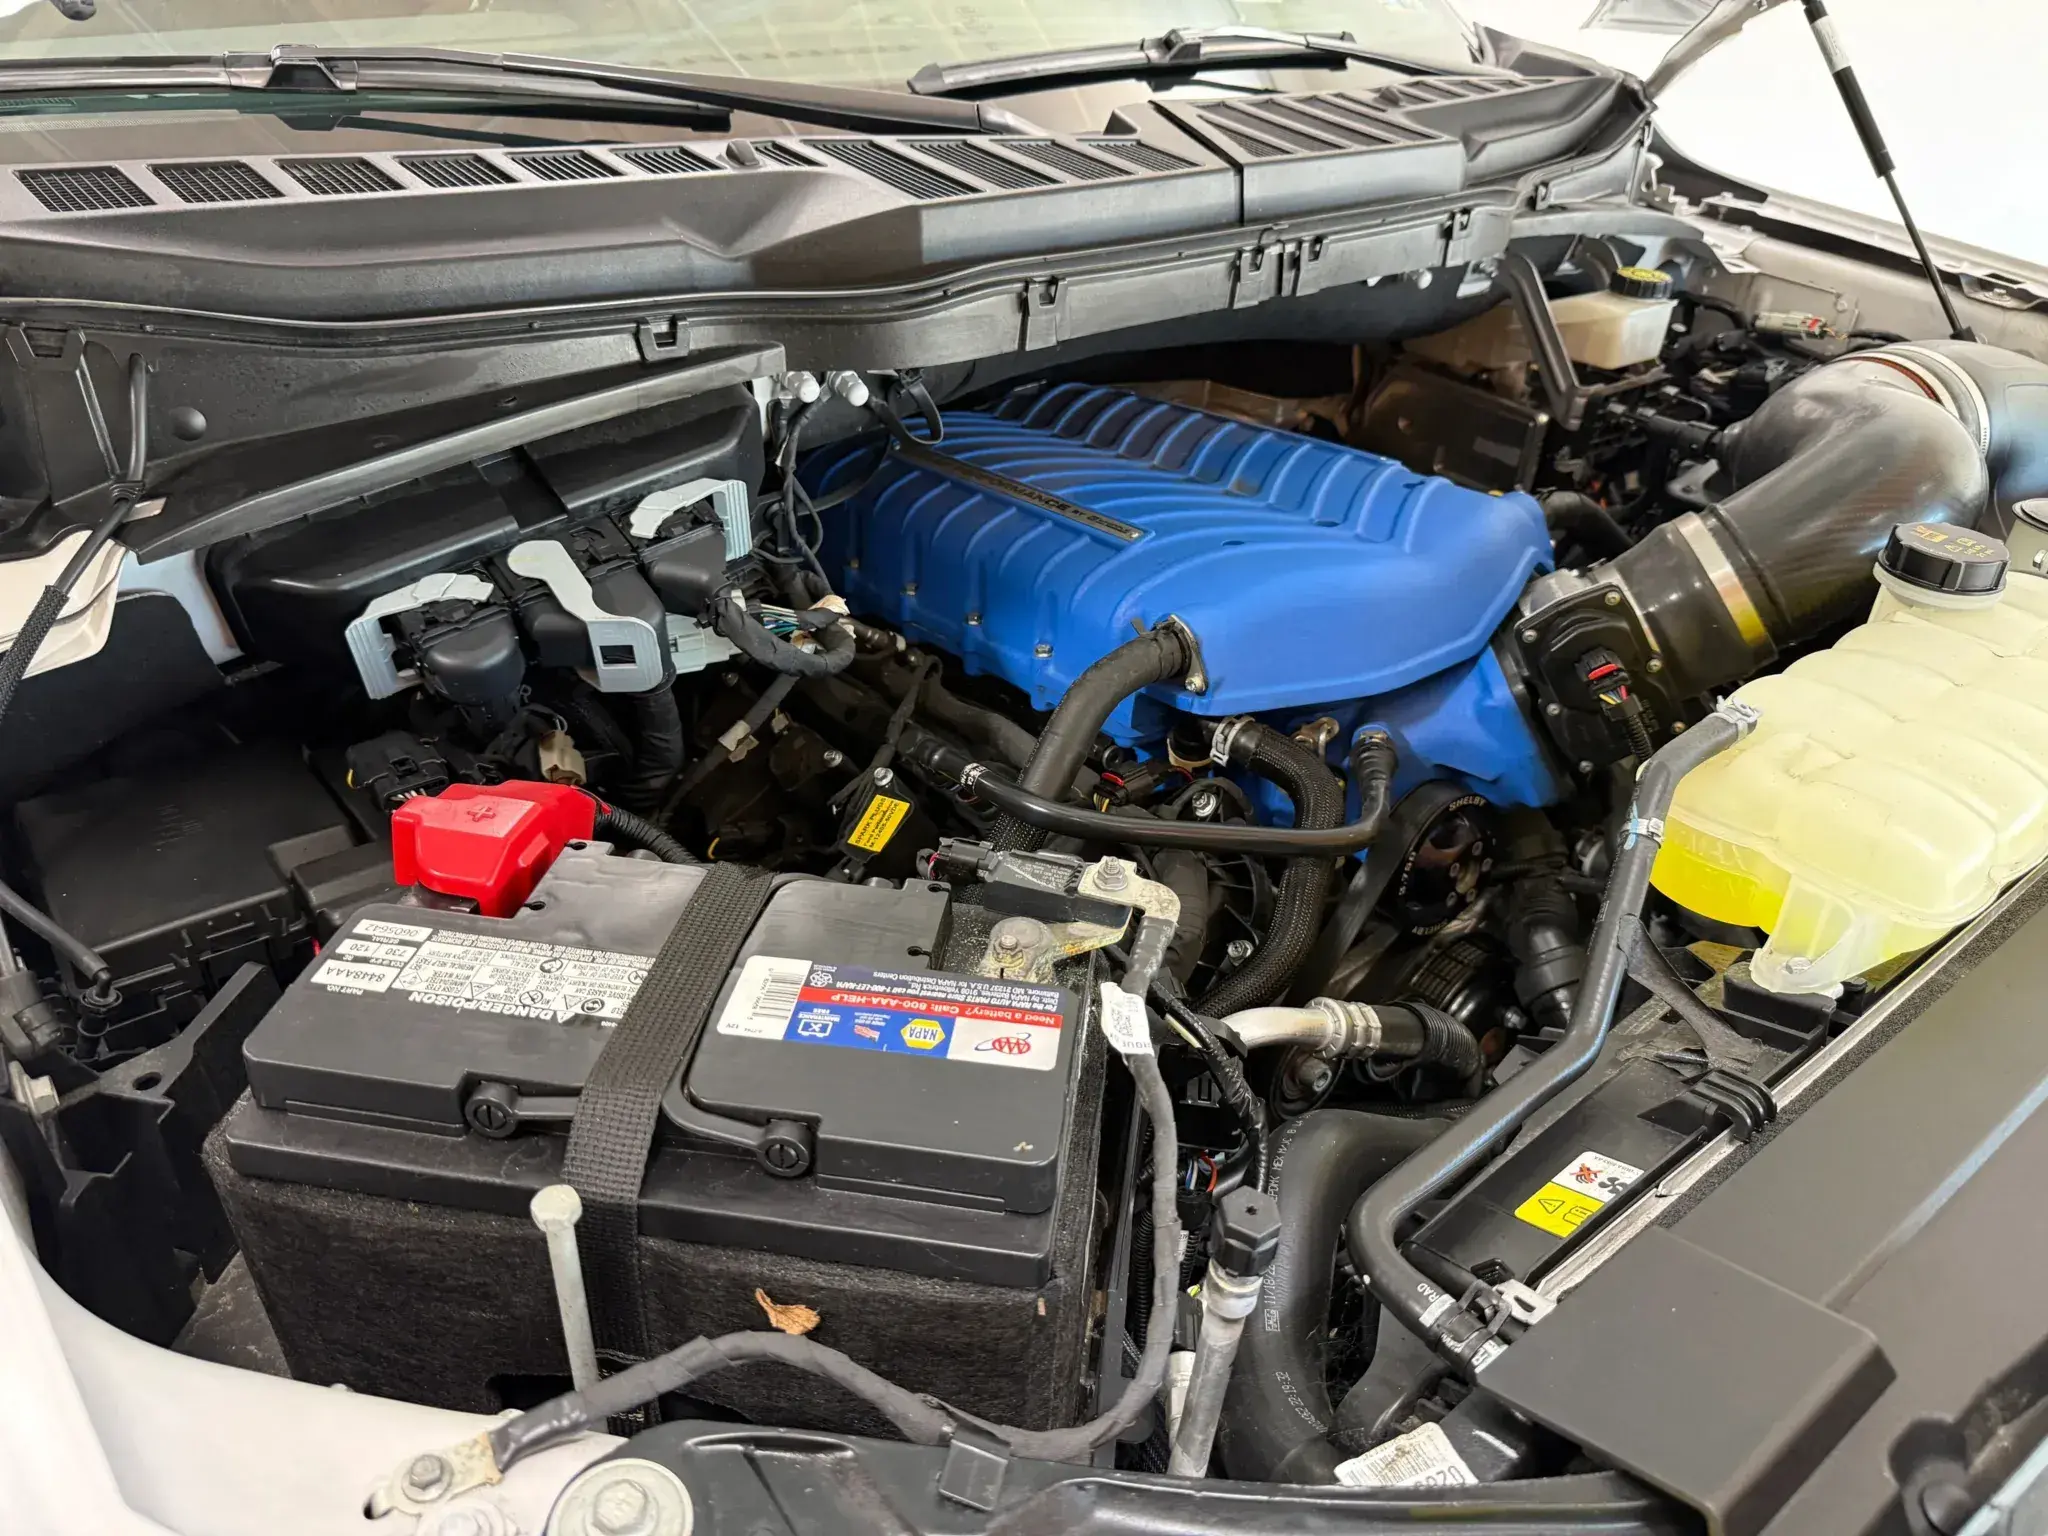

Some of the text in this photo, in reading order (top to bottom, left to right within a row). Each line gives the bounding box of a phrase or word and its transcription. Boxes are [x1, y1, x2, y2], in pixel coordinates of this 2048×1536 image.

[1449, 795, 1487, 812] SHELBY
[855, 797, 887, 844] SPARK PLUGS
[371, 935, 400, 944] SERIAL
[349, 943, 407, 957] 730 120
[449, 963, 475, 971] MEDICAL
[326, 967, 385, 983] 8448AAA
[873, 971, 898, 980] Centers
[899, 974, 937, 984] Distribution
[938, 979, 957, 987] NAPA
[326, 984, 364, 996] PART NO.
[906, 987, 920, 996] you
[922, 984, 959, 994] Yellowbrick
[990, 985, 1012, 993] 21237
[1013, 987, 1025, 995] MD
[1026, 988, 1059, 998] Baltimore,
[484, 993, 516, 1003] SULFURIC
[920, 990, 947, 999] nearest
[947, 993, 966, 1002] Store
[1010, 994, 1030, 1002] NAPA
[831, 993, 928, 1011] 800-AAA-HELP
[966, 995, 990, 1005] PARTS
[990, 998, 1011, 1007] AUTO
[1011, 1001, 1032, 1009] NAPA
[1041, 997, 1058, 1005] Distr.
[408, 991, 554, 1020] DANGER/POISON
[930, 1003, 960, 1014] Call:
[797, 1012, 840, 1022] MAINTENANCE
[965, 1006, 1012, 1020] battery?
[1025, 1014, 1055, 1025] Need
[908, 1026, 938, 1041] NAPA
[993, 1037, 1030, 1054] AAA
[1417, 1282, 1440, 1302] RAD
